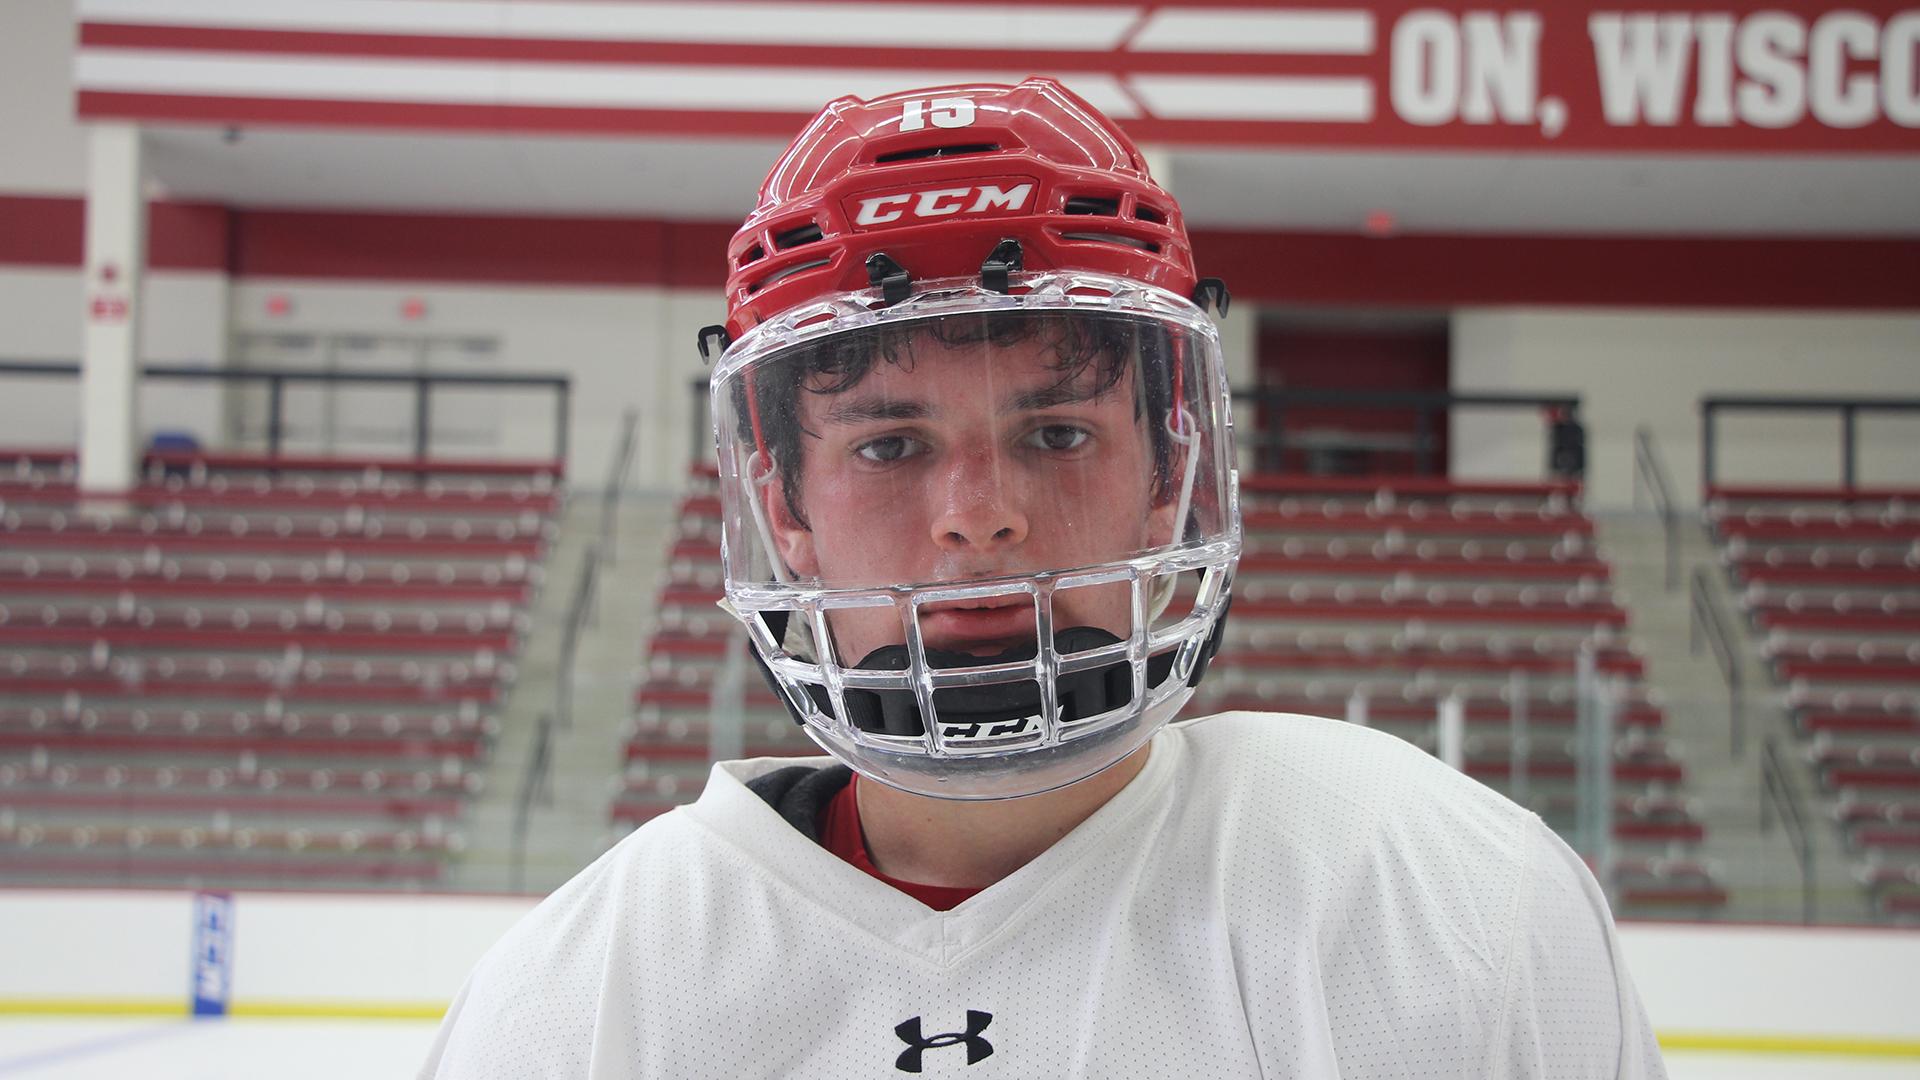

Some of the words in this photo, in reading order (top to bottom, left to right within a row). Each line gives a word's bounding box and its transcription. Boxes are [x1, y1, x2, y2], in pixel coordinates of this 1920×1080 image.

[1390, 9, 1568, 138] ON,
[899, 98, 975, 132] 15
[854, 183, 1034, 226] CCM
